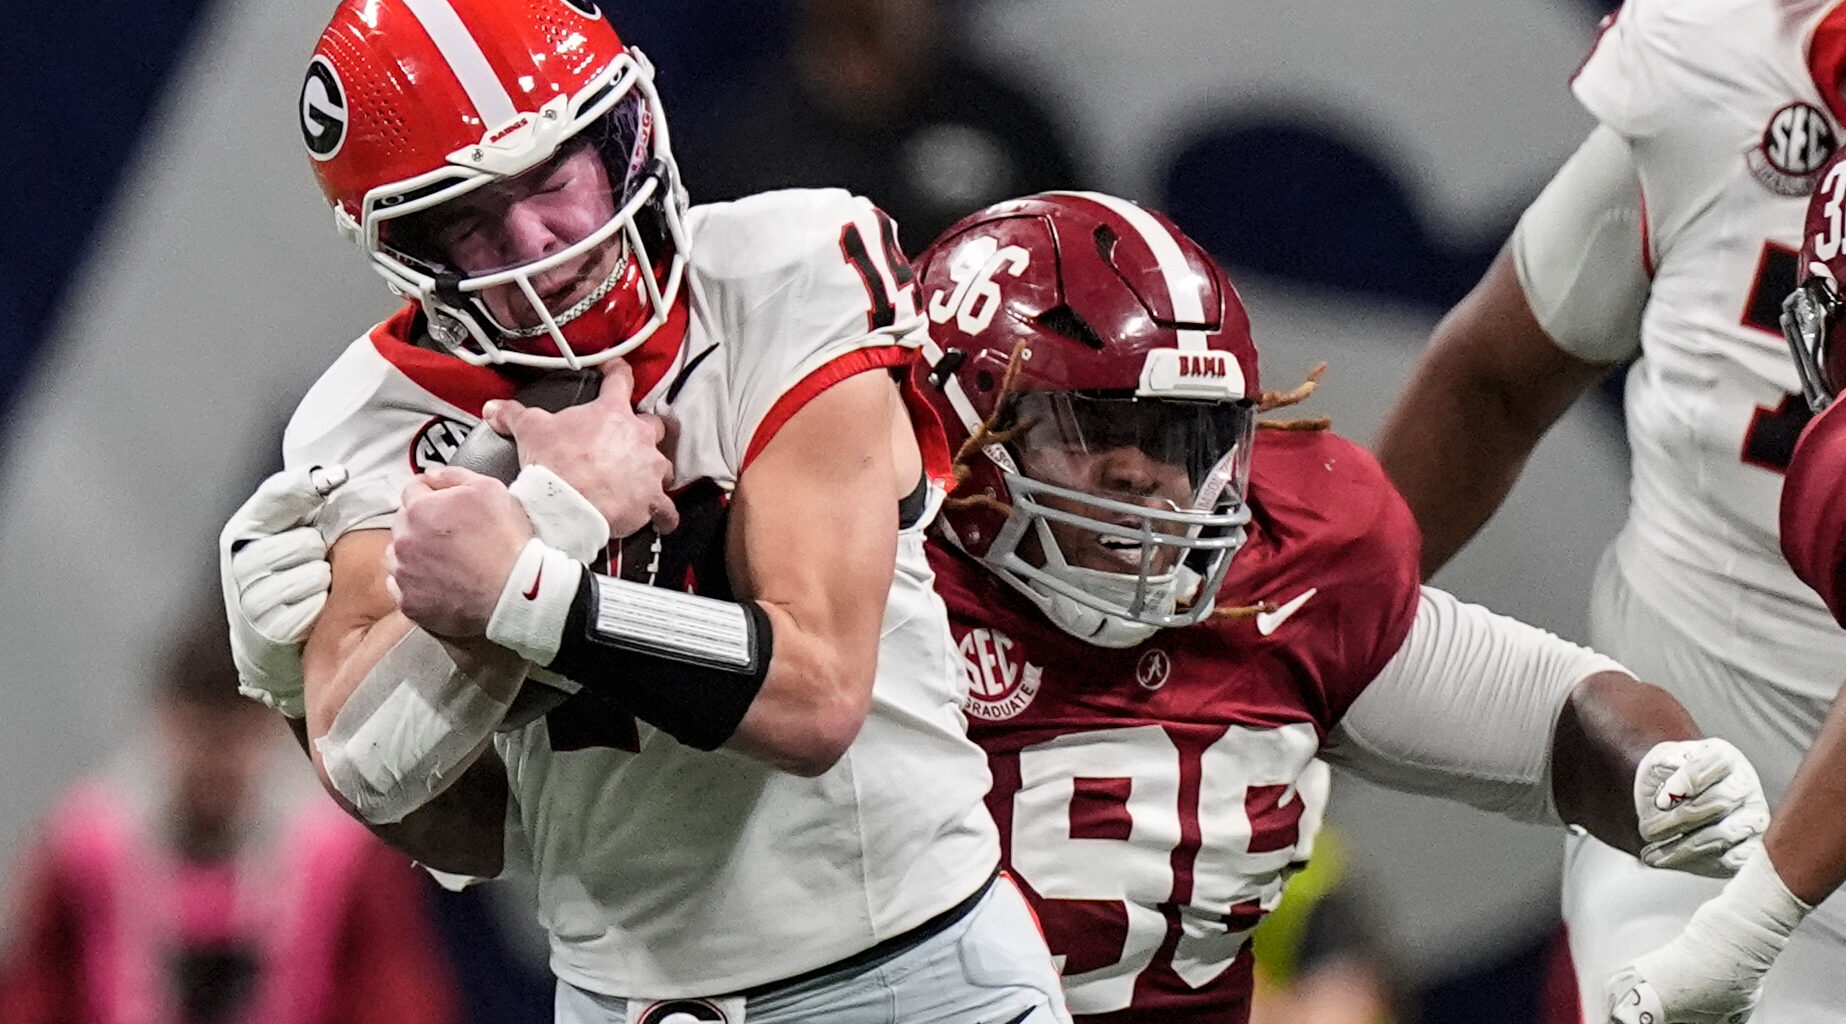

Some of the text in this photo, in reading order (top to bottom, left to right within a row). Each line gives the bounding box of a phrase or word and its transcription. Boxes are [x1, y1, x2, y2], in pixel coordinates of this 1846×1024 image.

[490, 117, 528, 143] DAWGS
[1767, 104, 1829, 173] SEC
[1815, 158, 1846, 262] 3
[929, 235, 1031, 336] 96
[1178, 355, 1226, 378] BAMA
[959, 626, 1019, 696] SEC
[1011, 723, 1319, 1015] 96
